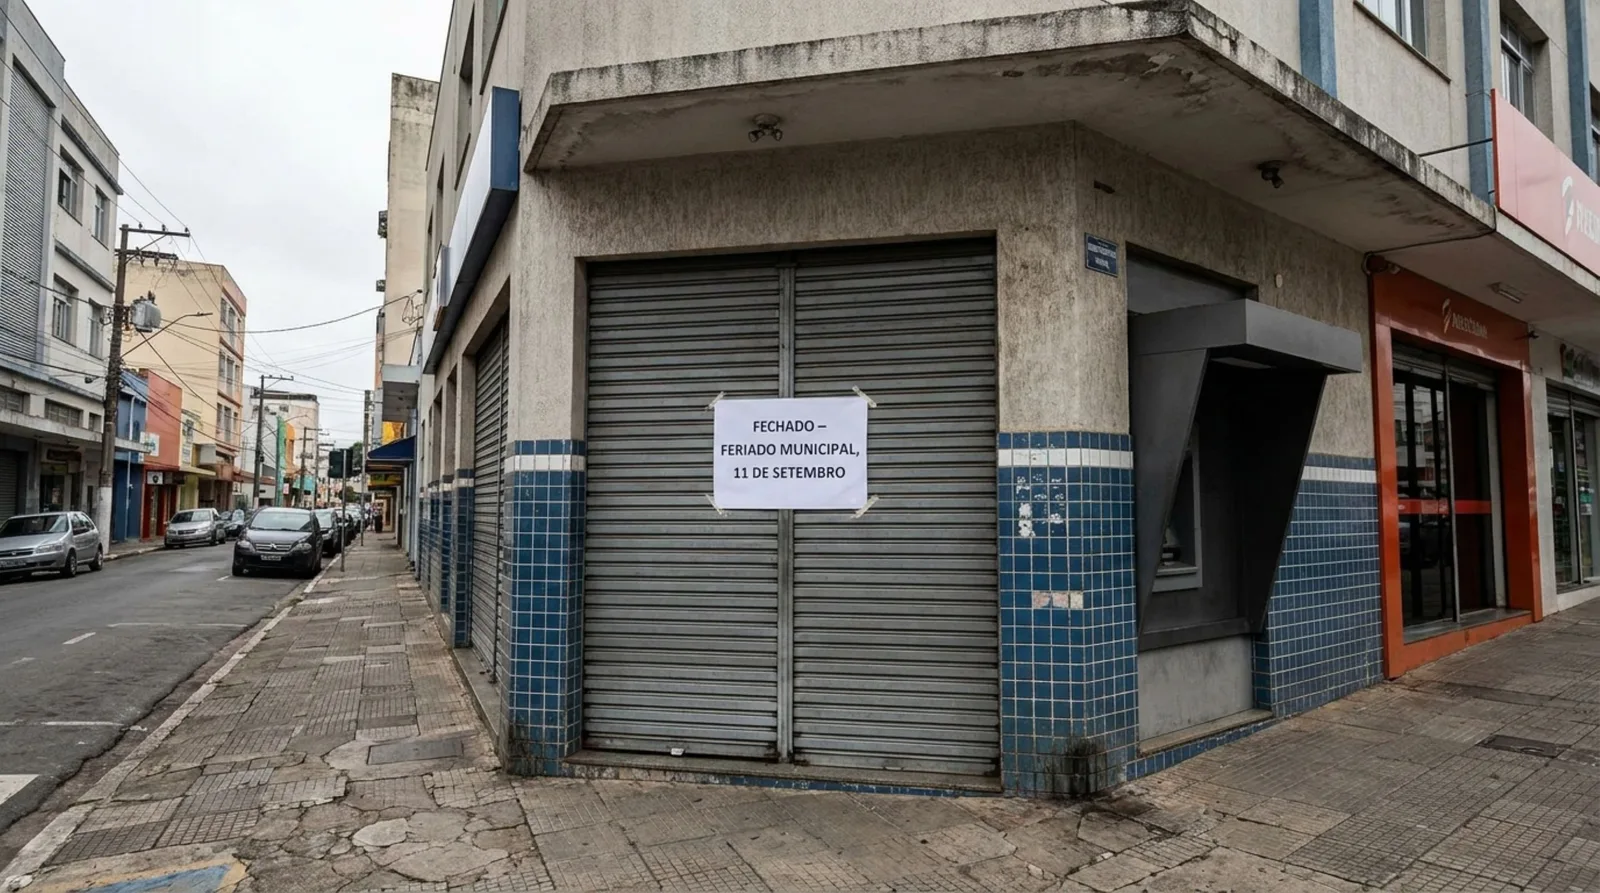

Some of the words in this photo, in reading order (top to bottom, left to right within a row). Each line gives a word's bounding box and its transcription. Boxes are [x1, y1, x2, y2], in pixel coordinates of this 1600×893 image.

[753, 420, 815, 432] FECHADO
[721, 444, 777, 456] FERIADO
[780, 443, 860, 457] MUNICIPAL,
[733, 467, 749, 479] 11
[752, 466, 769, 479] DE
[772, 466, 846, 479] SETEMBRO
